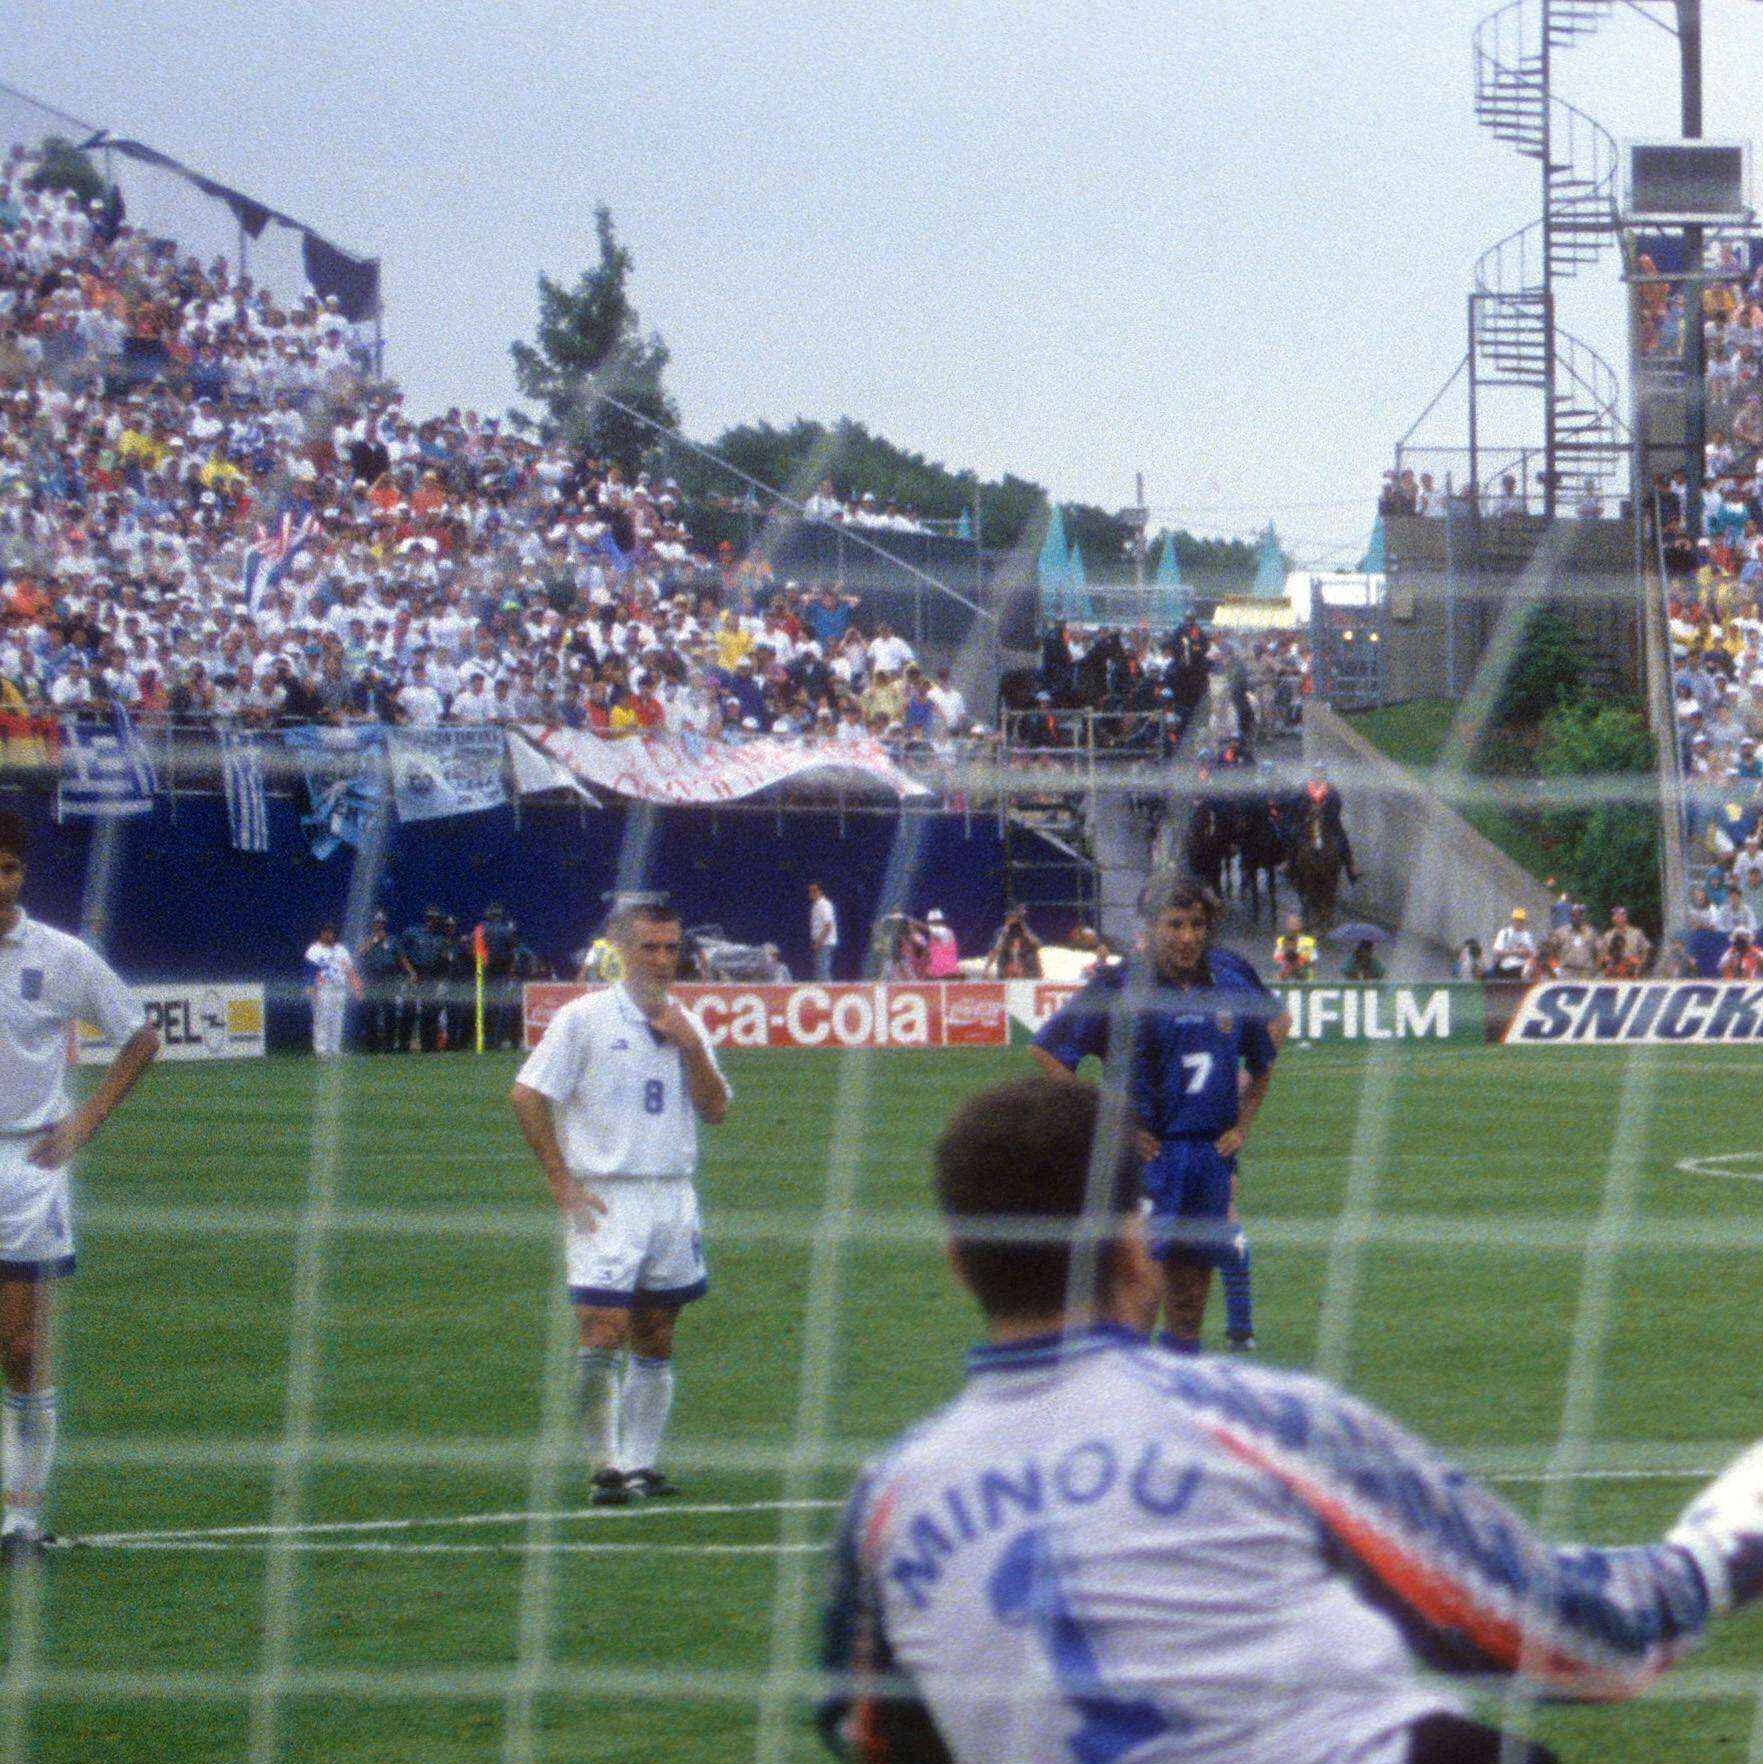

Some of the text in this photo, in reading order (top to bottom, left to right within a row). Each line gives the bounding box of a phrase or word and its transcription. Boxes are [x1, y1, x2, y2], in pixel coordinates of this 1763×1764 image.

[143, 999, 203, 1044] PEL
[692, 983, 929, 1047] ca-Cola
[1287, 989, 1450, 1040] IFILM
[644, 1078, 664, 1115] 8
[1180, 1052, 1214, 1094] 7
[891, 1436, 1206, 1611] MINOU
